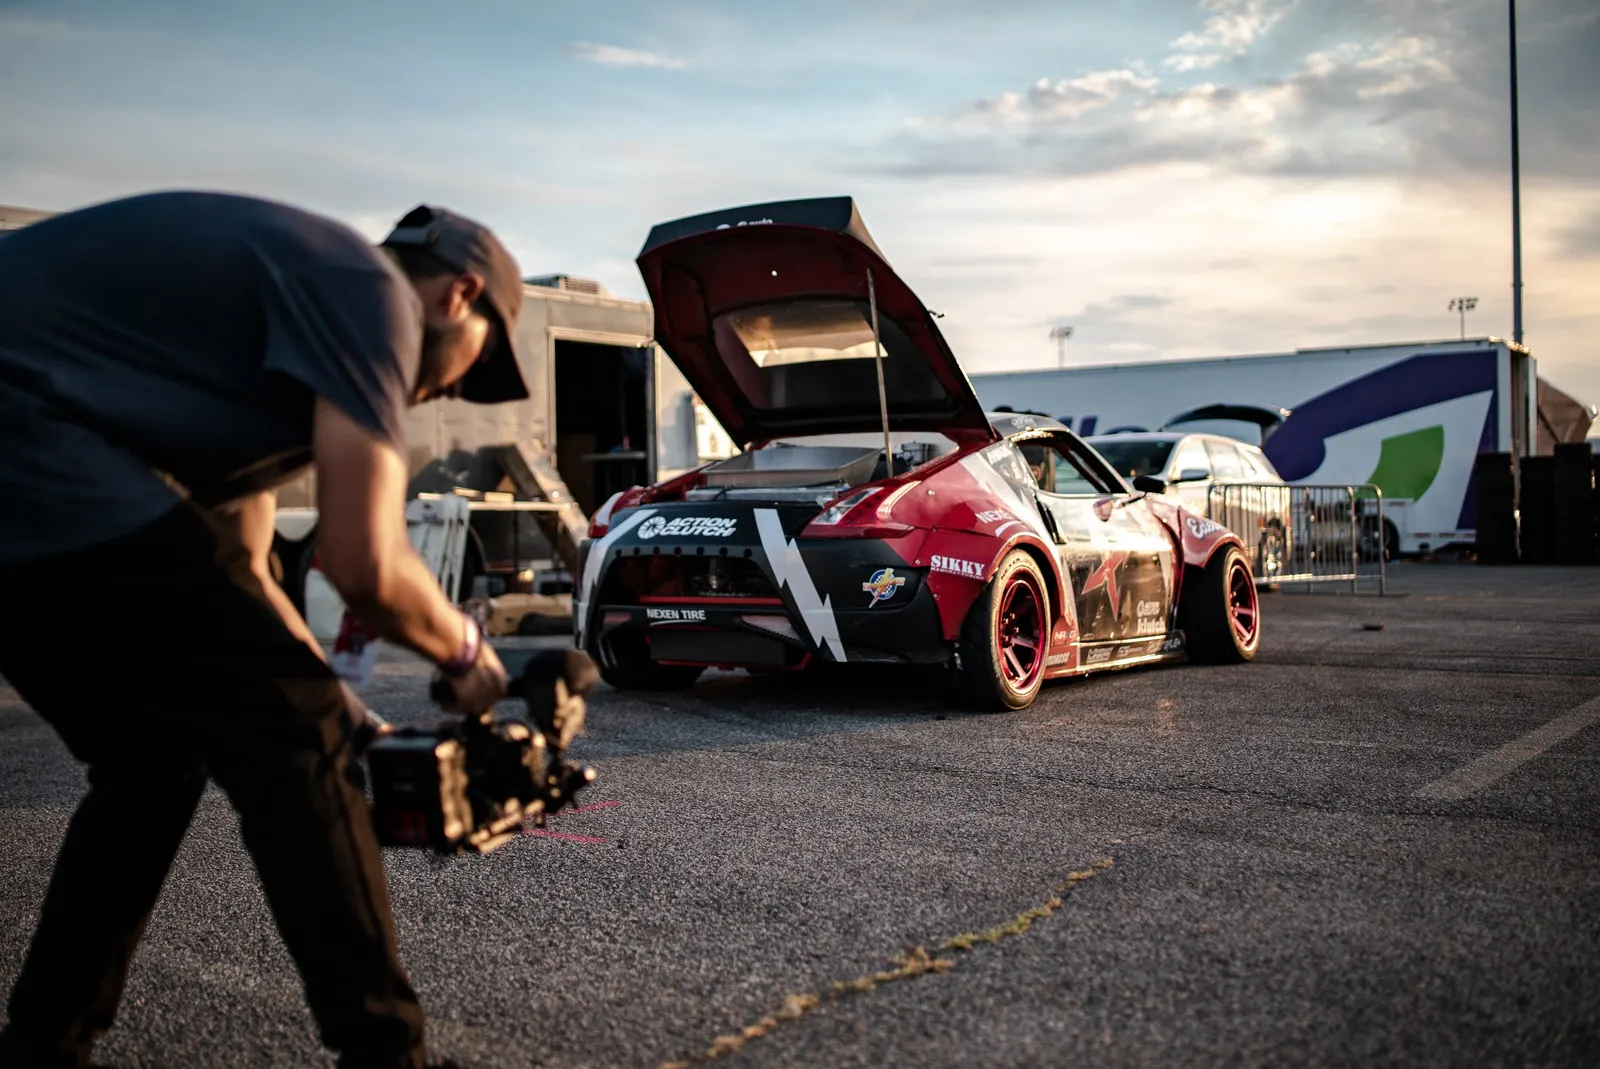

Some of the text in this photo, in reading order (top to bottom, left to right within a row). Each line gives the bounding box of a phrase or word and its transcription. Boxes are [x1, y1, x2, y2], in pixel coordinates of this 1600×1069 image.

[666, 517, 737, 527] ACTION
[659, 526, 737, 537] CLUTCH
[931, 554, 985, 576] SIKKY
[646, 608, 706, 620] NEXEN TIRE
